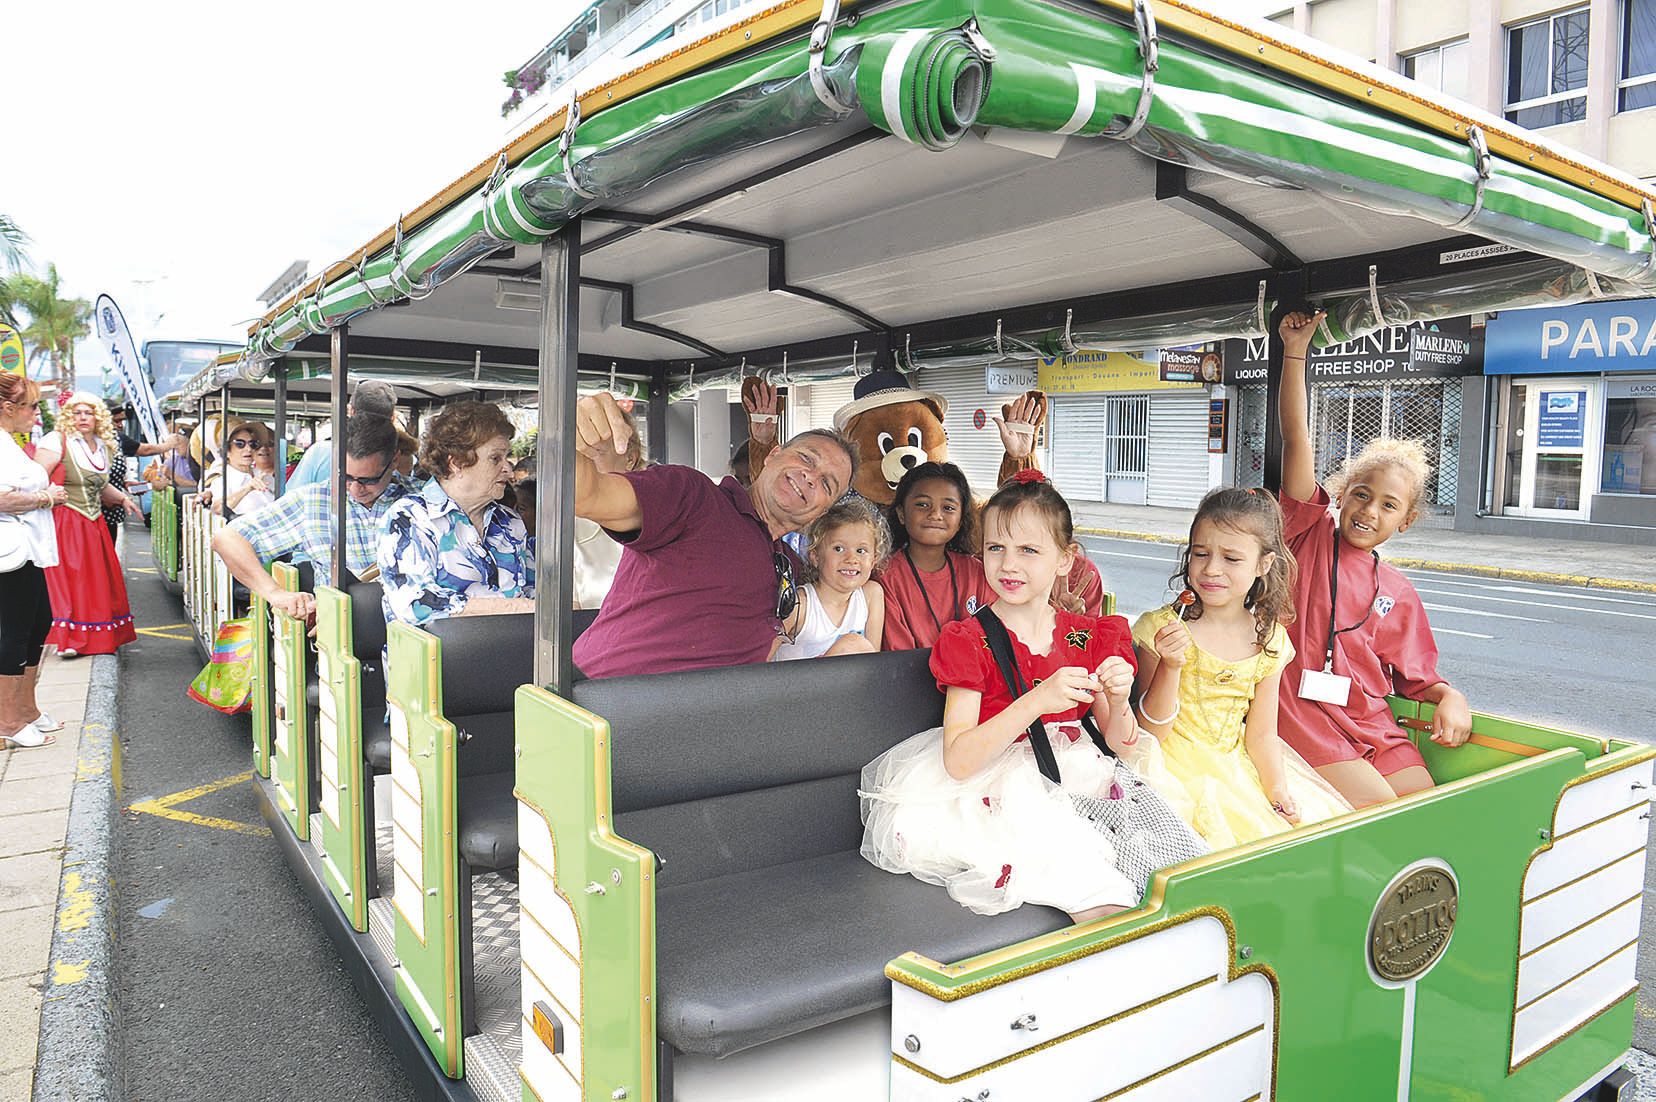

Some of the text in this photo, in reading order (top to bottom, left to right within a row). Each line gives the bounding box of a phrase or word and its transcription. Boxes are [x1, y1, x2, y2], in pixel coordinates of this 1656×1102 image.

[1454, 250, 1479, 260] PLACES
[1480, 245, 1508, 256] ASSISES
[1416, 334, 1463, 354] MARLENE
[1062, 352, 1108, 364] ONDRAND
[1415, 351, 1462, 365] DUTY FREE SHOP
[1315, 361, 1352, 375] FREE
[1353, 359, 1395, 374] SHOP
[990, 373, 1034, 386] PREMIUM
[1398, 874, 1439, 904] TRAINS
